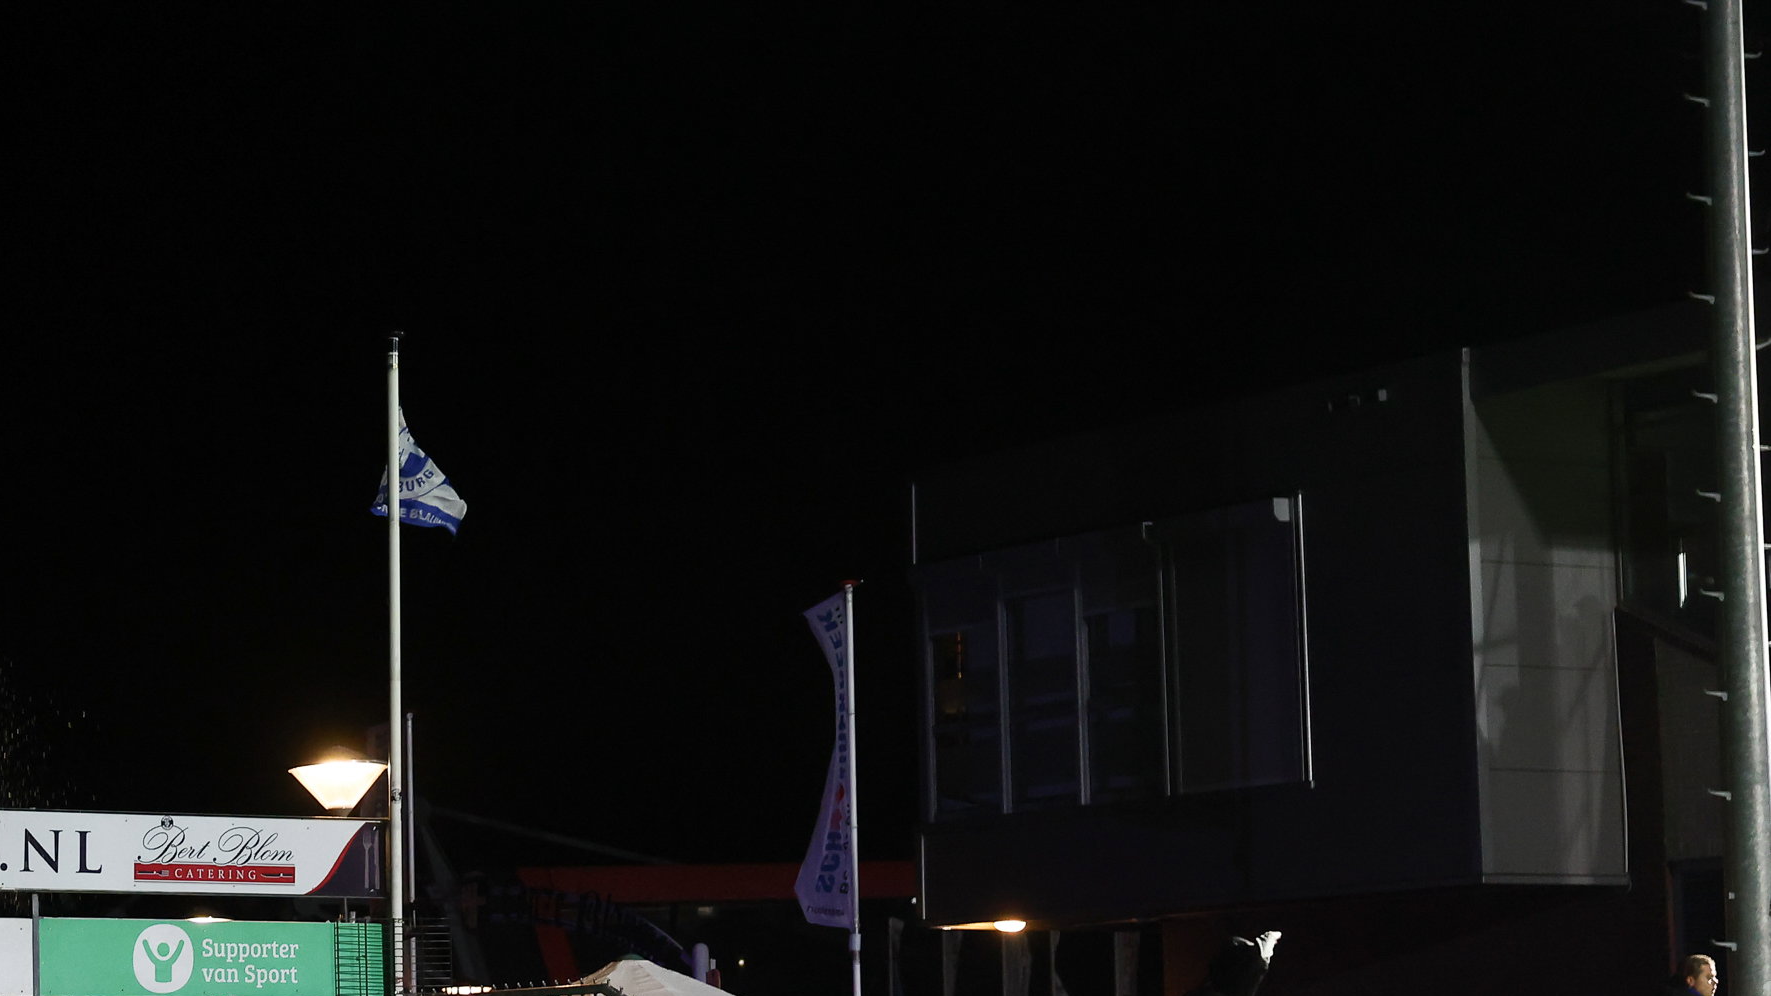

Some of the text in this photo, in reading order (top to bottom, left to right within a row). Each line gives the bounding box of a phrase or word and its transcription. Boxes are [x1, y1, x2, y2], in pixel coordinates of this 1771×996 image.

[135, 823, 295, 864] Bert Blom
[174, 867, 258, 882] CATERING
[201, 937, 300, 964] Supporter
[201, 963, 299, 987] van Sport
